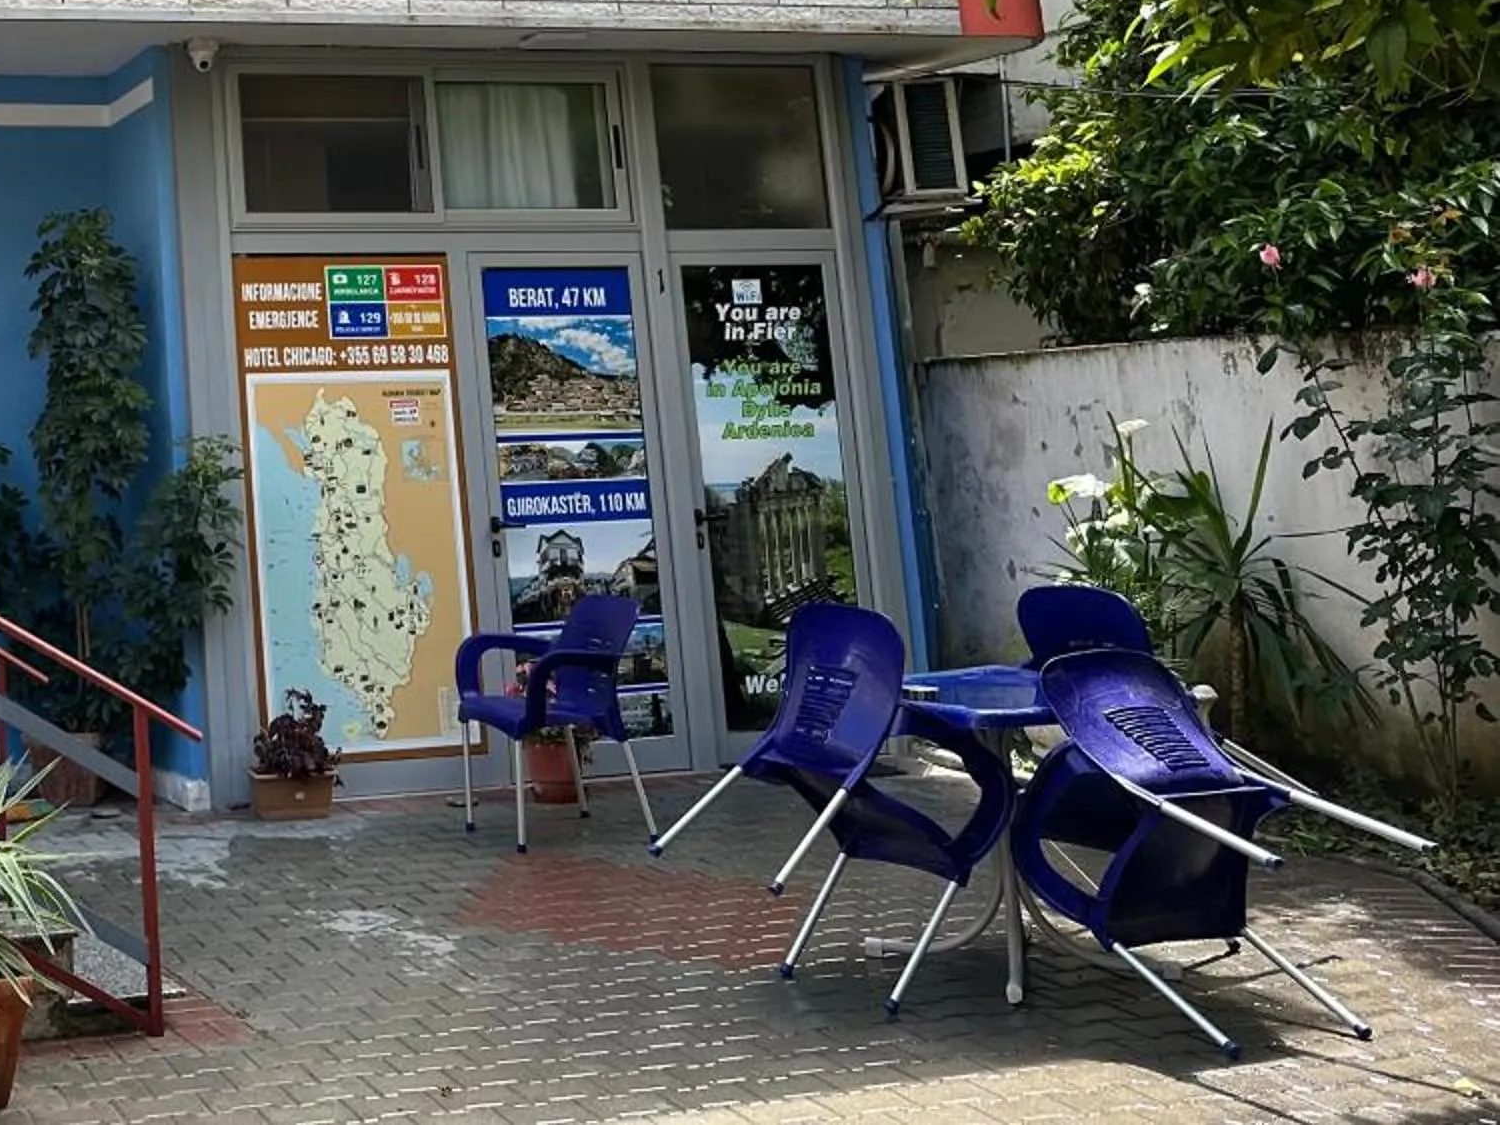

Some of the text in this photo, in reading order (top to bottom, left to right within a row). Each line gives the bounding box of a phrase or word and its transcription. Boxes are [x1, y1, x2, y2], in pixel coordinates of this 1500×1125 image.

[356, 274, 377, 286] 127
[508, 286, 607, 309] BERAT, 47 KM
[360, 312, 381, 324] 129
[715, 303, 801, 322] You are
[724, 321, 797, 341] in Fier
[244, 347, 281, 367] HOTEL
[283, 346, 337, 367] CHICAGO:
[339, 345, 369, 365] +355
[372, 345, 388, 365] 69
[408, 344, 423, 364] 30
[722, 359, 801, 375] You are
[507, 491, 647, 517] GJIROKASTËR, 110 KM
